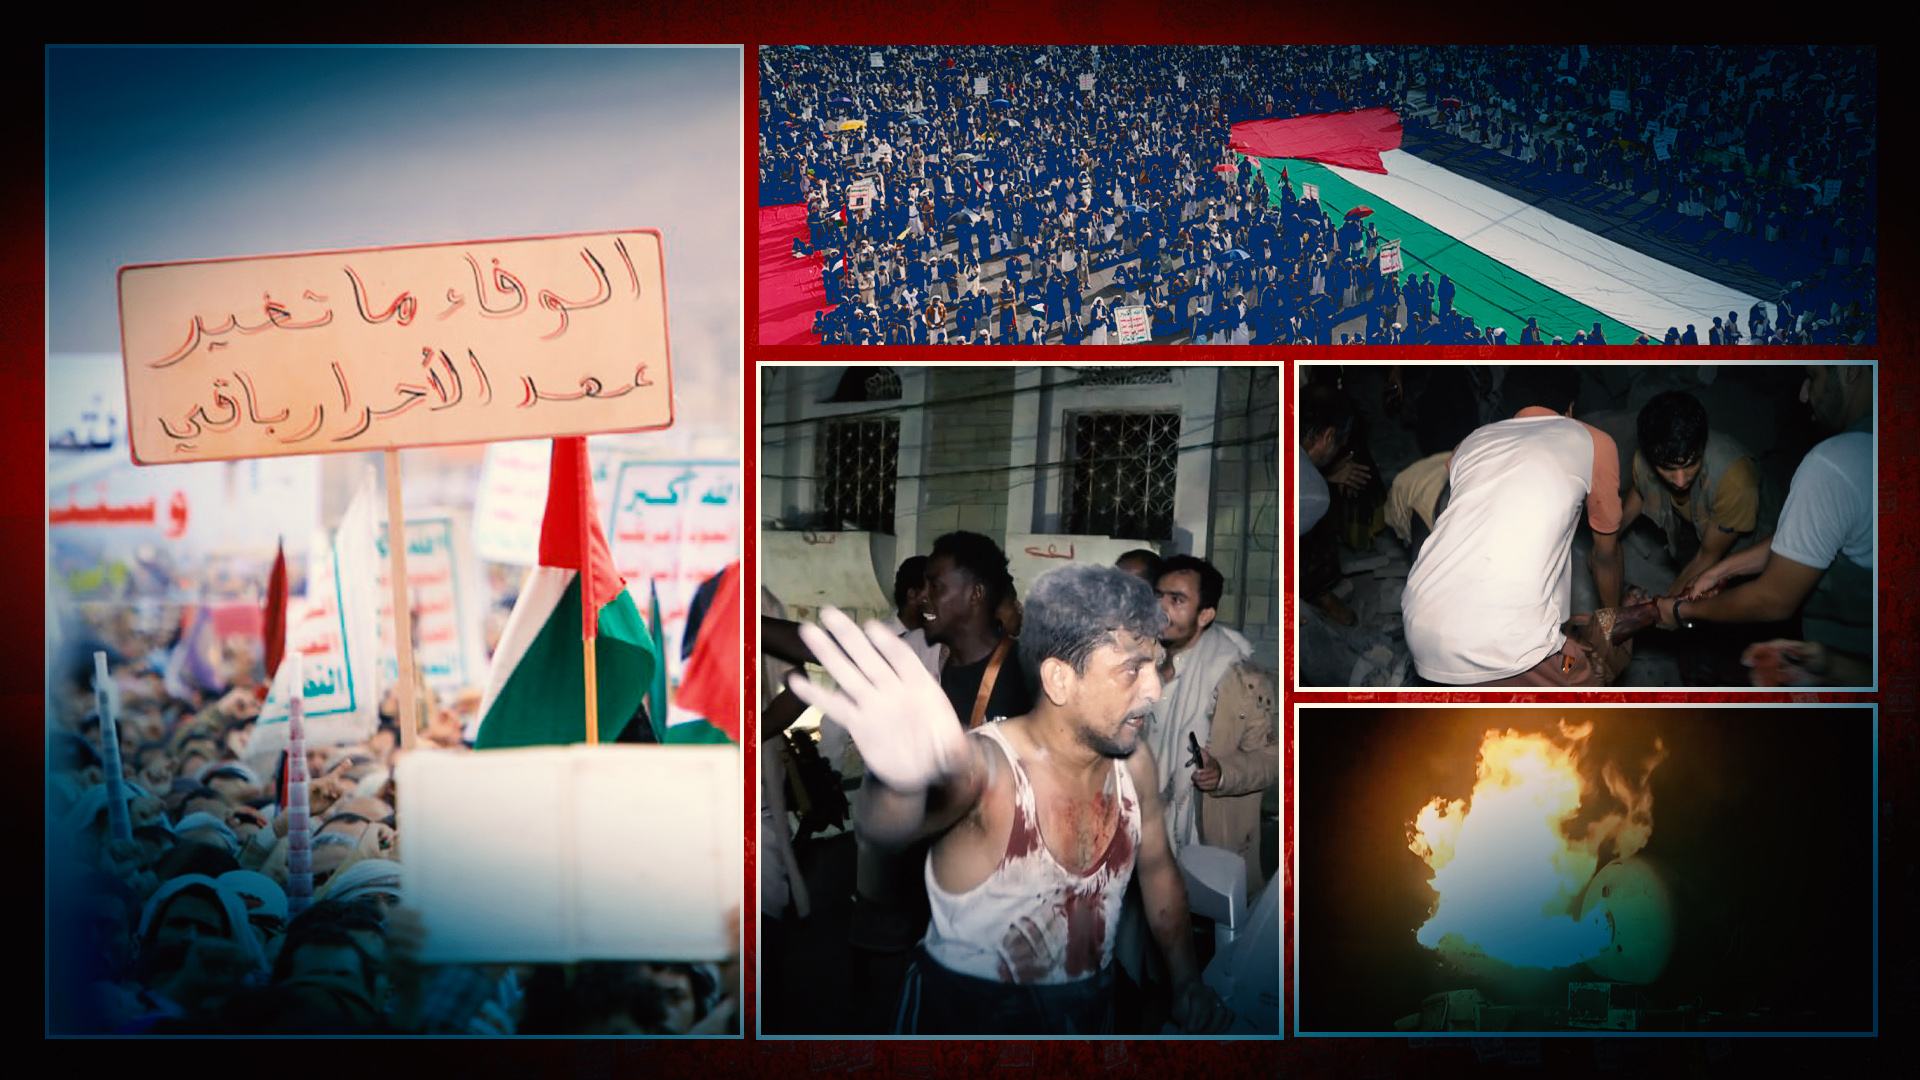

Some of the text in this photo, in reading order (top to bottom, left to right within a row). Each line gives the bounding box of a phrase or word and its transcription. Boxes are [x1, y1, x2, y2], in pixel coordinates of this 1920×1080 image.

[146, 237, 641, 369] الوفاء ما تغير
[158, 346, 655, 454] عهد الأحرار باقي
